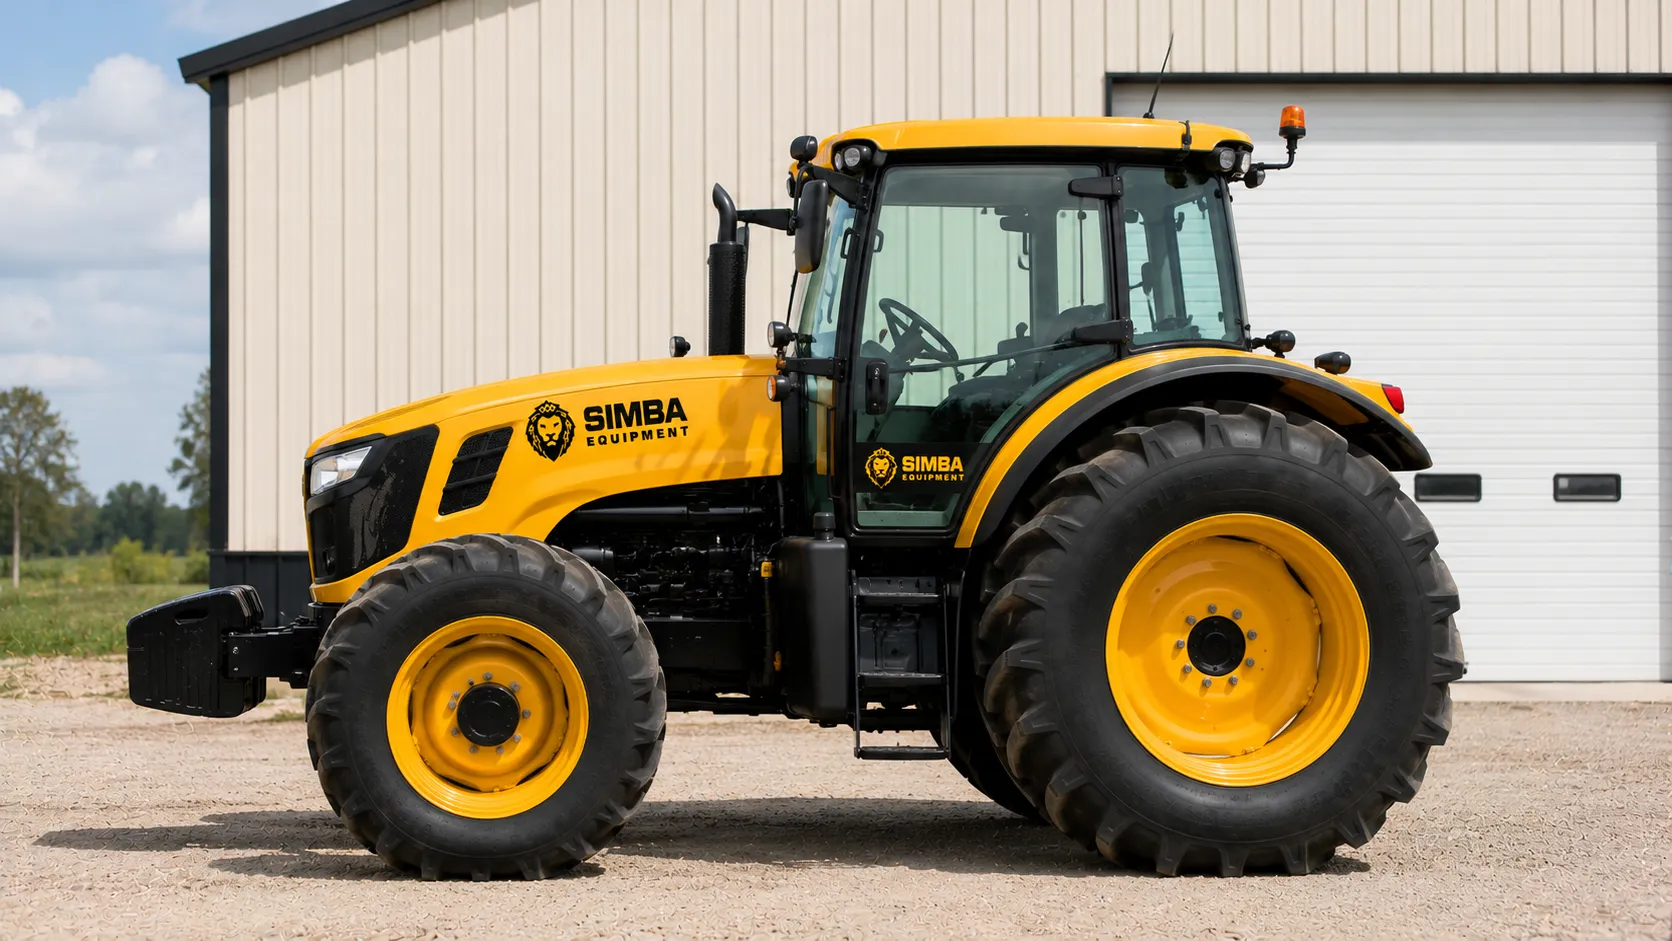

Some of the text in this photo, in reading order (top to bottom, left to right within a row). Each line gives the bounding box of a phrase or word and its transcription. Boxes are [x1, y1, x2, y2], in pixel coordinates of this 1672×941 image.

[583, 397, 688, 432] SIMBA
[586, 426, 689, 447] EQUIPMENT
[902, 456, 964, 472] SIMBA
[902, 474, 965, 482] EQUIPMENT
